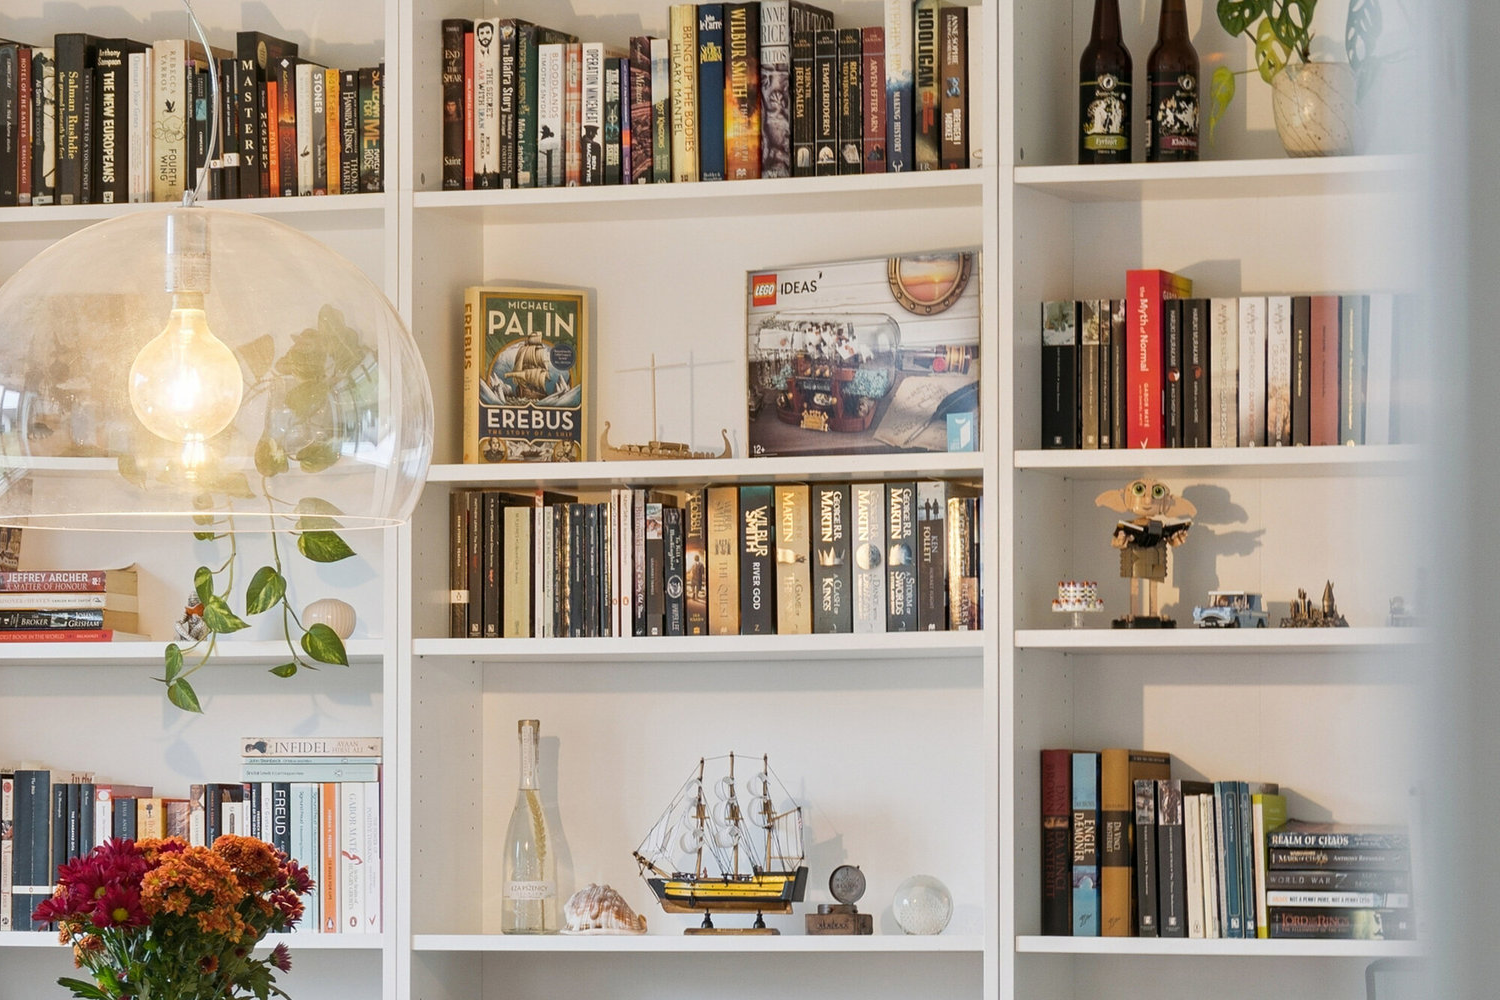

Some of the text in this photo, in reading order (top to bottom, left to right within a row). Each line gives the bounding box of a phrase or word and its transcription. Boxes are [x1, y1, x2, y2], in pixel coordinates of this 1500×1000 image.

[540, 52, 548, 86] TIMOTHY
[730, 8, 748, 98] WILBUR SMITH
[918, 8, 934, 88] HOOLIGAN
[169, 50, 177, 95] REBECCA
[313, 72, 323, 115] STONER
[550, 52, 559, 120] BLOODLANDS
[586, 49, 599, 125] OPERATION MINCEMEAT
[672, 43, 683, 136] HILARY MANTEL
[682, 26, 694, 152] BRING UP THE BODIES
[67, 71, 79, 160] Salman Rushdie
[241, 60, 253, 166] MASTERY
[363, 100, 373, 117] FOR
[822, 62, 830, 136] TEMPELRIDDEREN
[102, 71, 115, 183] THE NEW EUROPEANS
[259, 112, 268, 169] MASTERY
[342, 91, 355, 154] HANNIBAL RISING
[362, 119, 381, 150] ME
[159, 156, 169, 182] WING
[167, 148, 178, 188] FOURTH
[269, 131, 277, 166] POWER
[362, 148, 374, 171] ROSE
[508, 301, 555, 311] MICHAEL
[780, 281, 818, 296] IDEAS
[488, 310, 574, 338] PALIN
[1136, 298, 1149, 326] Myth
[464, 303, 472, 370] EREBUS
[1139, 334, 1149, 372] Normal
[487, 408, 574, 430] EREBUS
[687, 494, 703, 540] HOBBIT
[745, 510, 757, 553] SMITH
[755, 505, 768, 557] WILBUR
[782, 492, 795, 542] MARTIN
[820, 491, 833, 542] MARTIN
[857, 489, 871, 542] MARTIN
[890, 488, 903, 540] MARTIN
[923, 526, 931, 562] FOLLETT
[7, 573, 89, 582] JEFFREY ARCHER
[752, 561, 761, 610] RIVER GOD
[822, 577, 834, 612] KINGS
[894, 571, 906, 616] SWORDS
[20, 617, 49, 626] BROKER
[67, 619, 100, 627] GRISHAM
[274, 741, 330, 754] INFIDEL
[275, 789, 286, 835] FREUD
[1073, 812, 1085, 862] DÆMONER
[1084, 819, 1096, 855] ENGLE
[1106, 821, 1114, 853] MYSTERIET
[1272, 835, 1349, 846] REALM OF CHAOS
[1271, 876, 1304, 884] WORLD
[1335, 873, 1348, 888] Z
